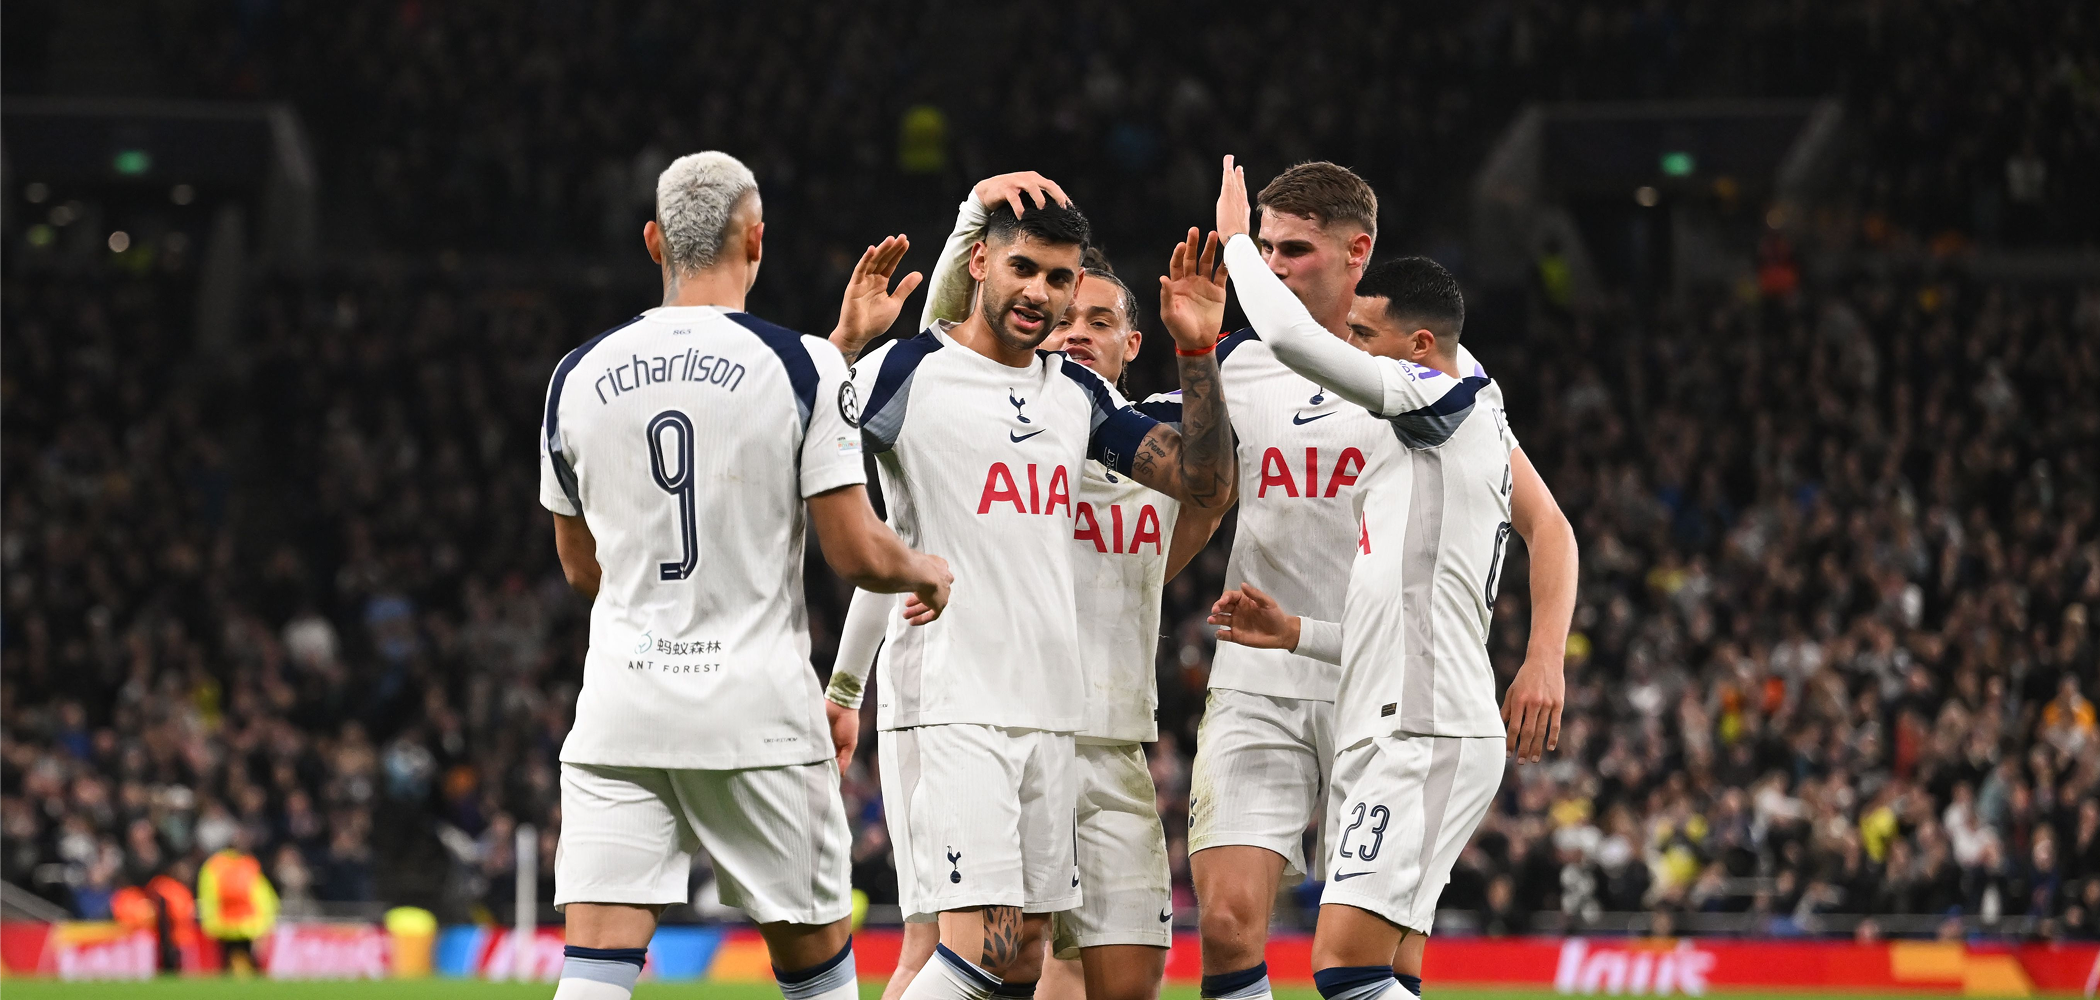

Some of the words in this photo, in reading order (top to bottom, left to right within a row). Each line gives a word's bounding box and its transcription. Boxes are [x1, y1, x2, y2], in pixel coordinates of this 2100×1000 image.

[595, 348, 745, 404] richarlison
[646, 409, 698, 581] 9
[977, 462, 1071, 518] AIA
[1258, 447, 1366, 498] AIA
[1074, 502, 1161, 555] AIA
[628, 661, 653, 670] ANT
[663, 664, 720, 673] FOREST
[656, 638, 721, 655] 蚂蚁森林
[1340, 802, 1391, 861] 23
